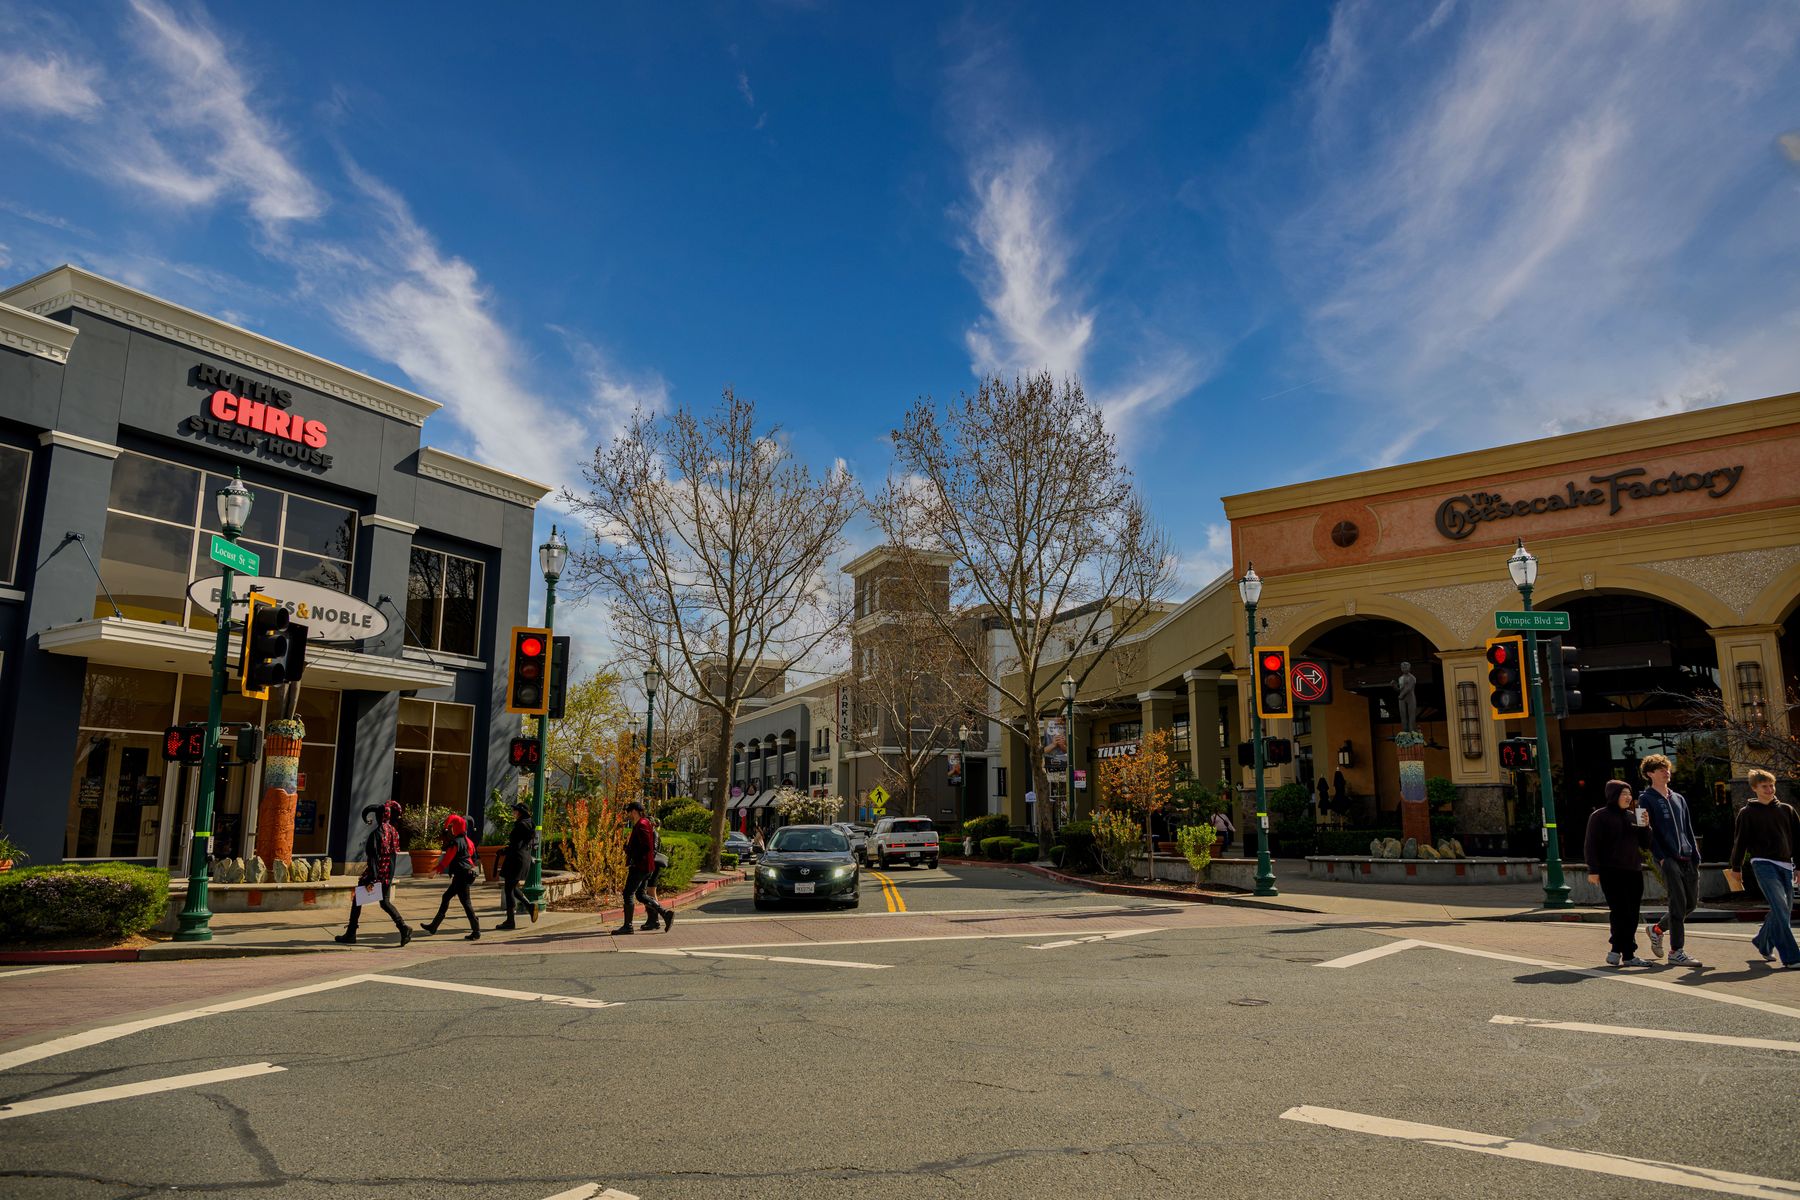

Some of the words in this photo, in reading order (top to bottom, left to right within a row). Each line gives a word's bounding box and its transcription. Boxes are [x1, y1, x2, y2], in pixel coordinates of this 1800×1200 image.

[200, 363, 292, 409] RUTH'S
[190, 415, 259, 446] STEAK
[268, 438, 333, 469] HOUSE
[210, 390, 328, 449] CHRIS
[1435, 481, 1605, 540] Cheesecake
[1472, 492, 1502, 506] The
[1590, 465, 1744, 516] Factory
[215, 543, 236, 561] Locust
[239, 554, 245, 565] St
[312, 606, 372, 629] NOBLE
[1499, 616, 1531, 626] Olympic
[1534, 617, 1551, 625] Blvd
[841, 687, 849, 740] PARKING
